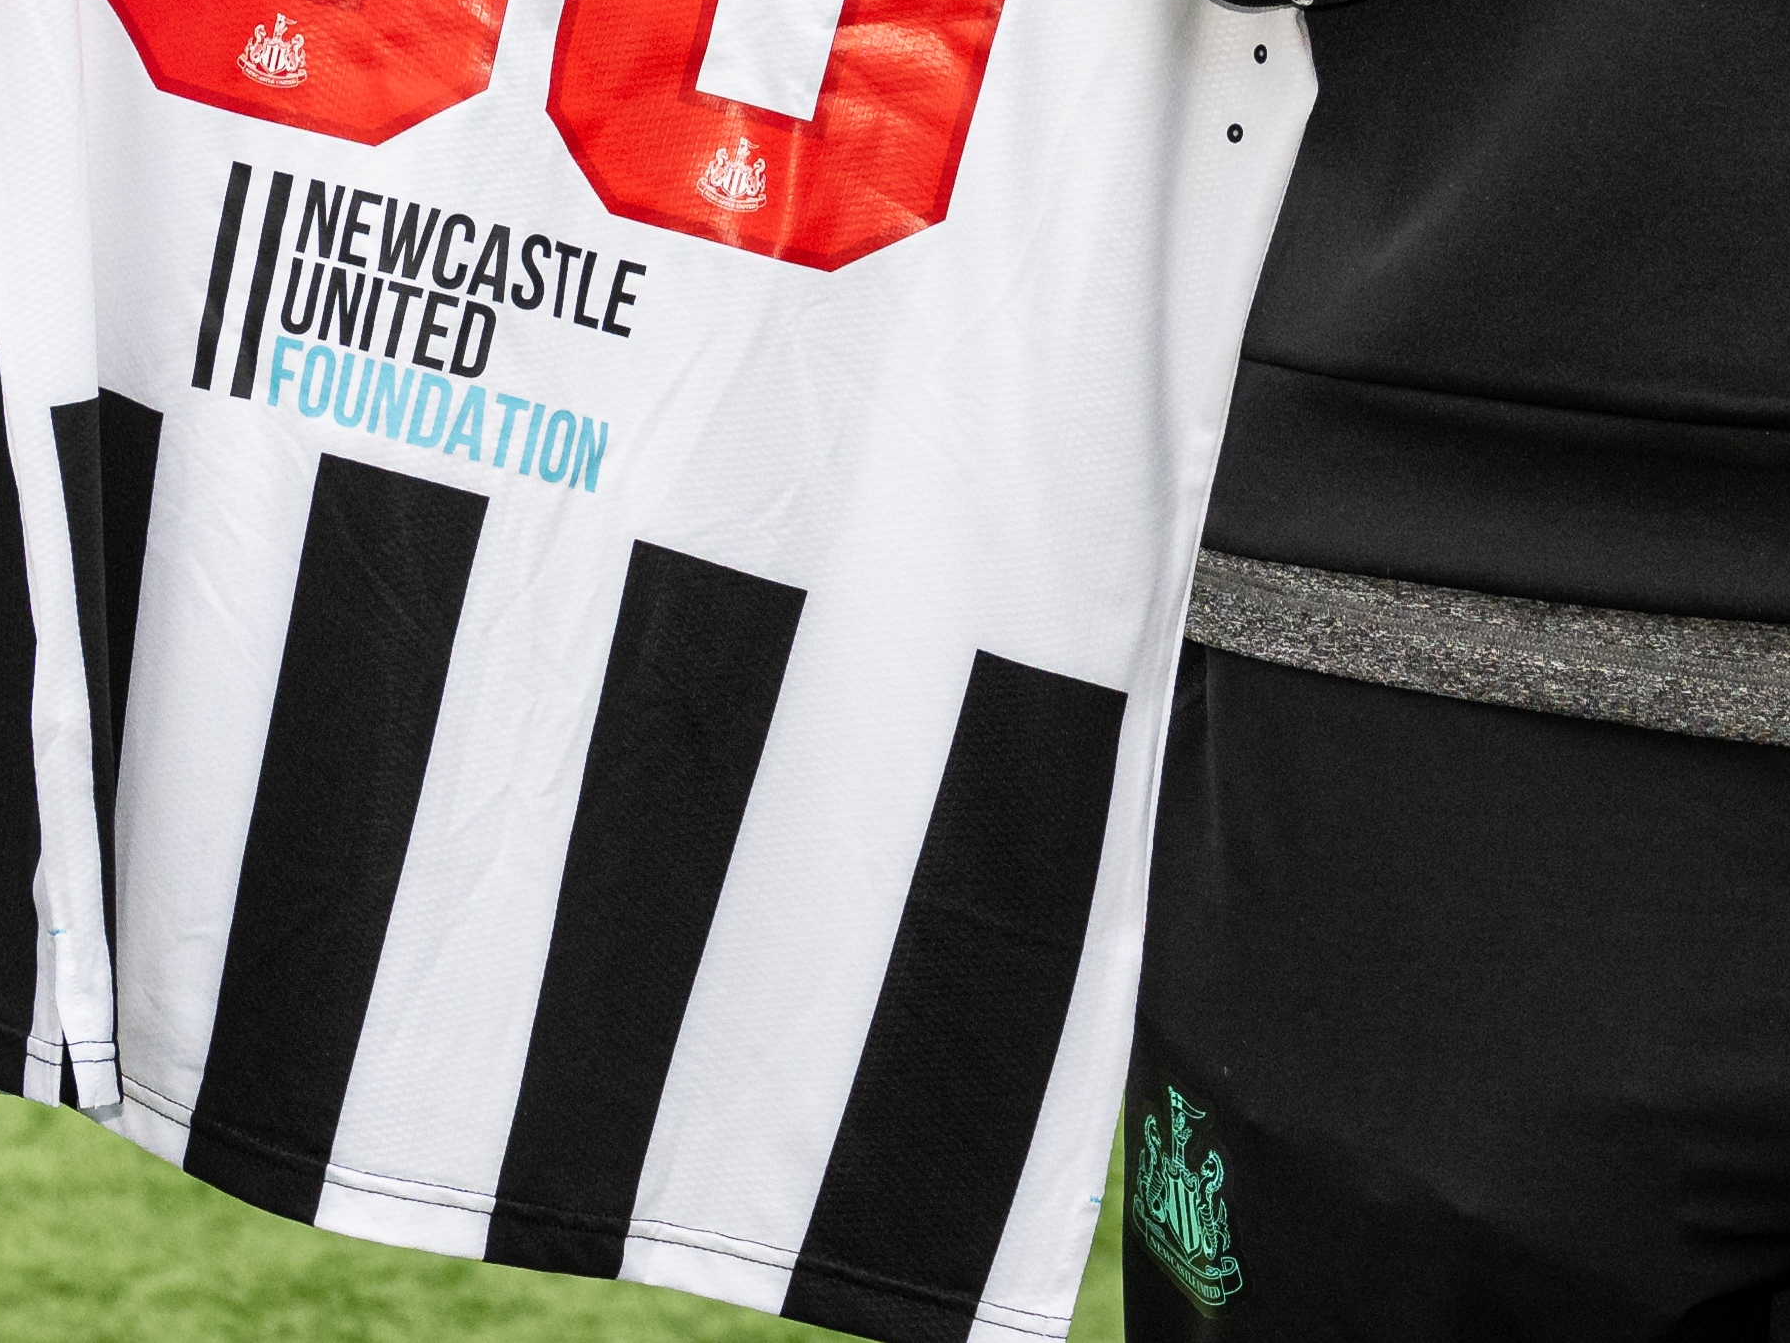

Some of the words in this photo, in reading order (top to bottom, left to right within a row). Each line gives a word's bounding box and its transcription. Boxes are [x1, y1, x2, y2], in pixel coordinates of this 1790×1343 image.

[280, 256, 497, 379] UNITED
[294, 178, 647, 339] NEWCASTLE
[266, 334, 609, 494] FOUNDATION
